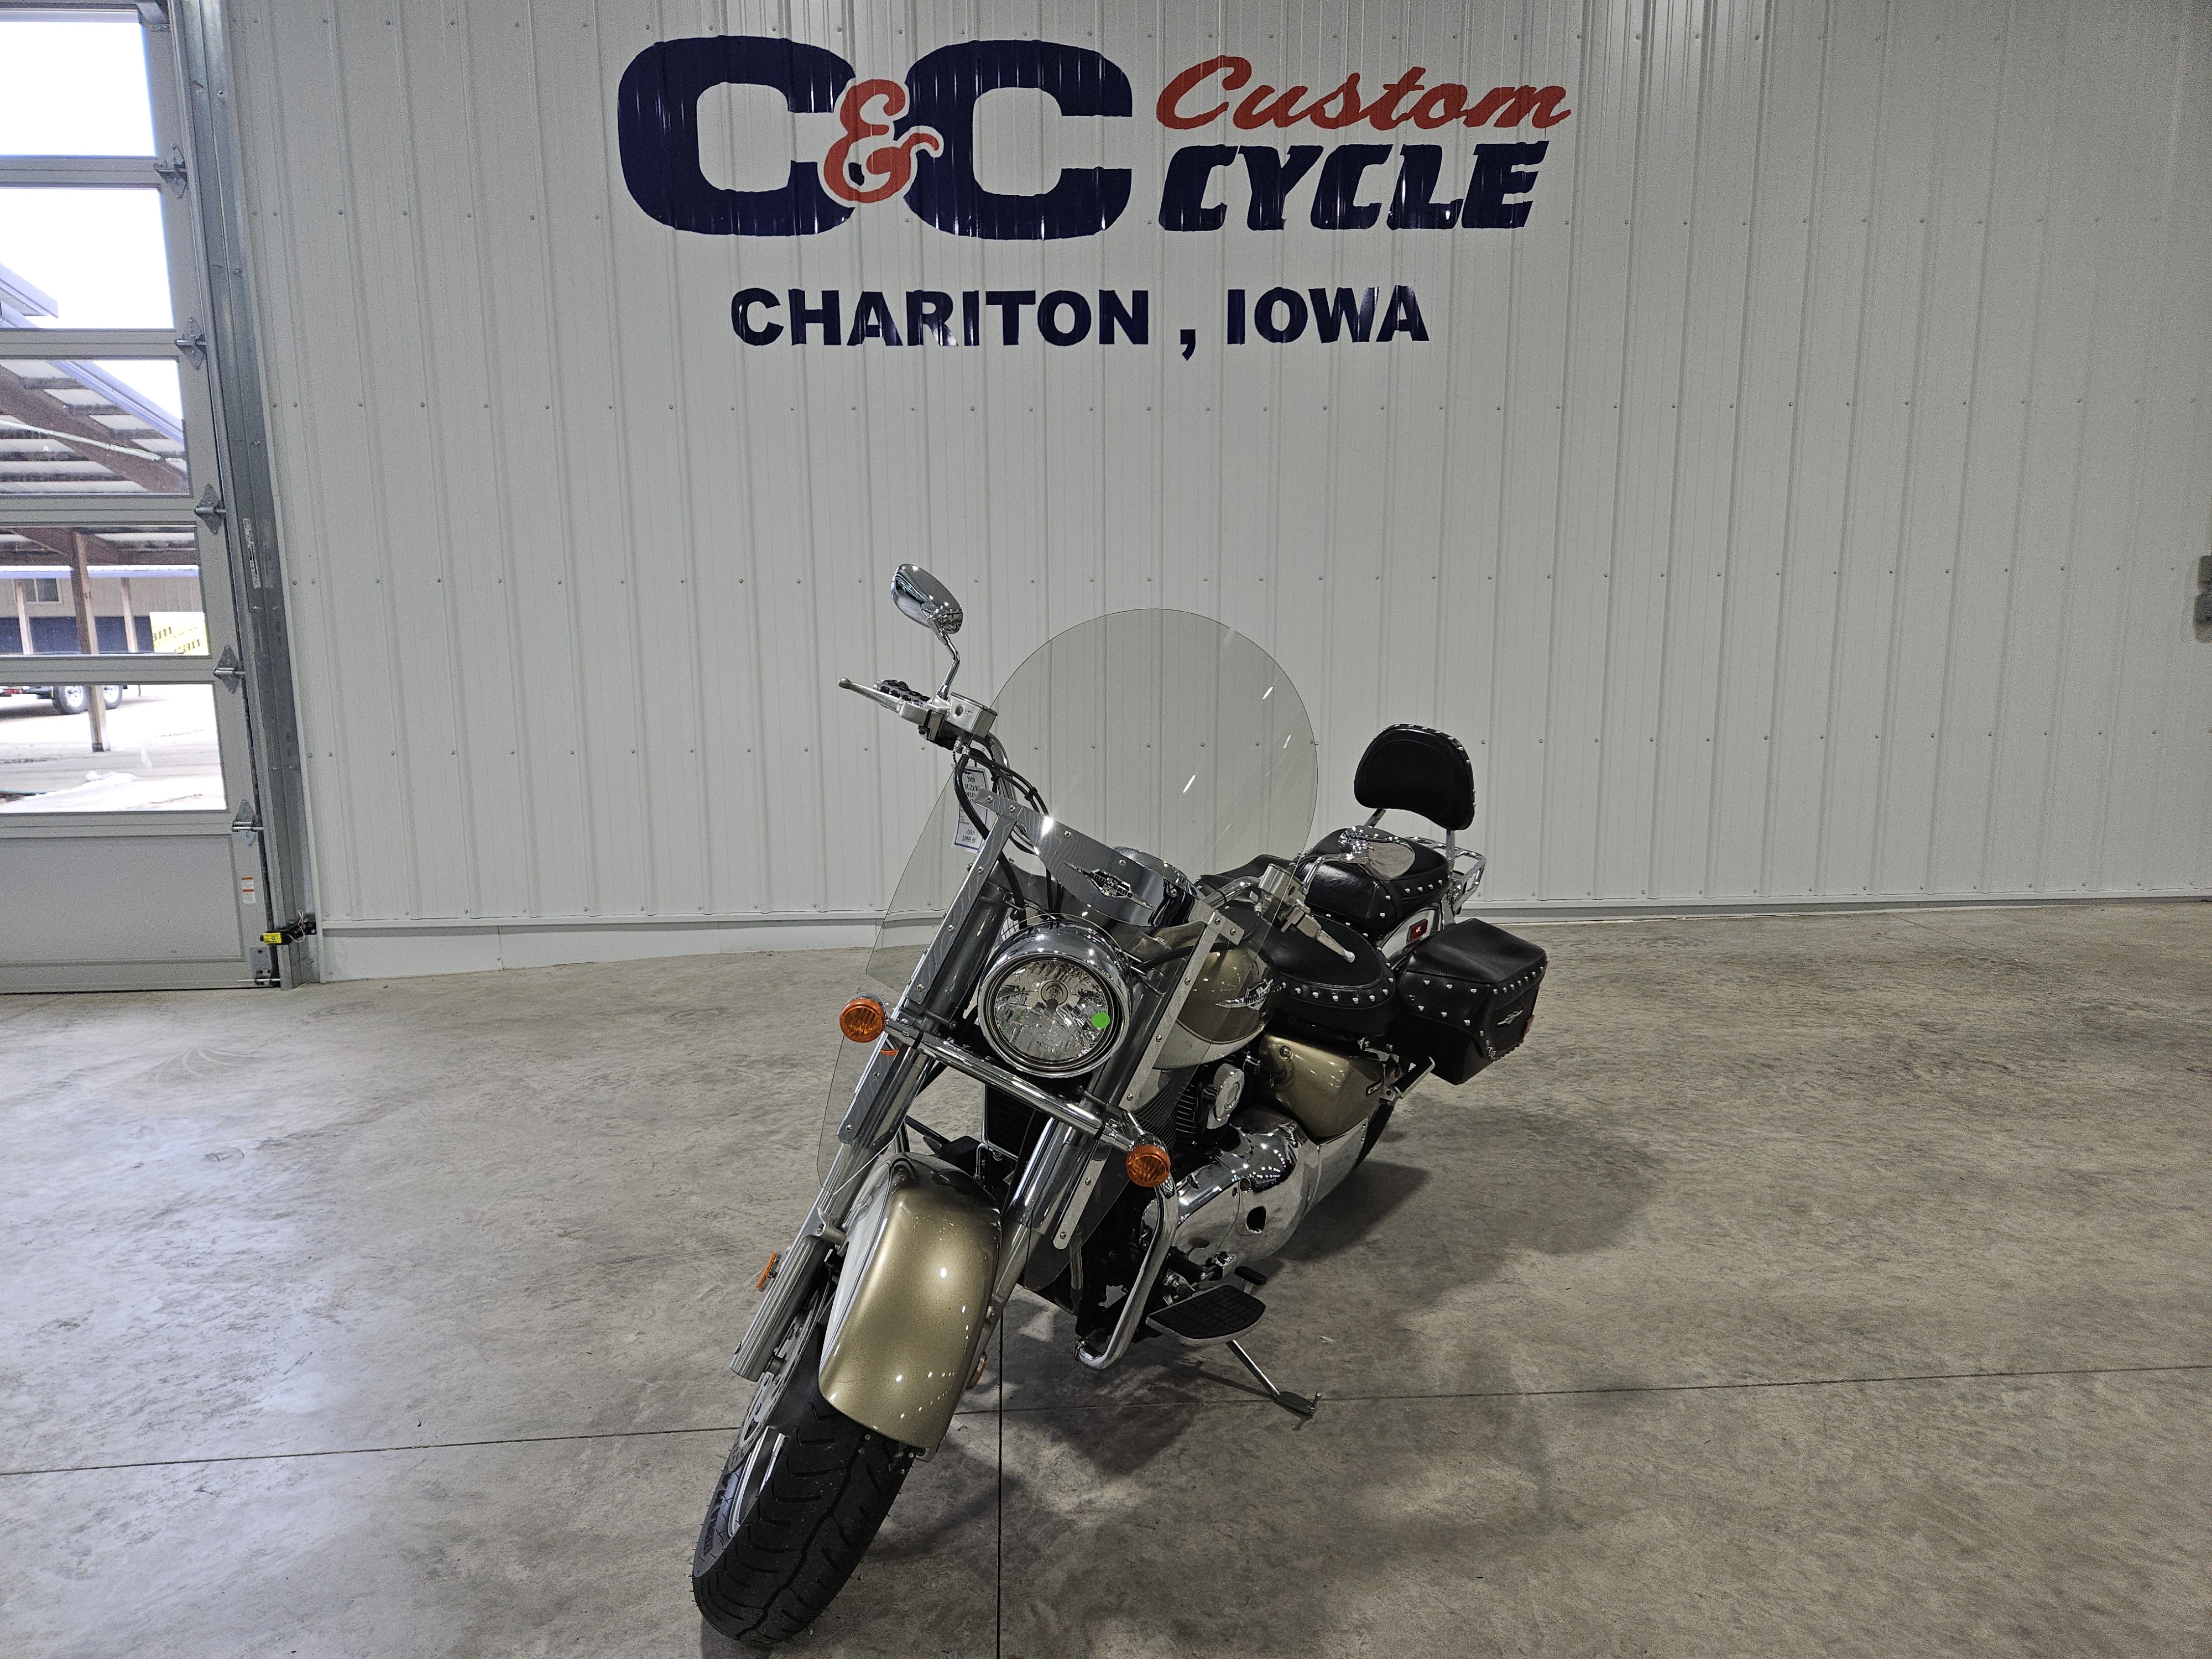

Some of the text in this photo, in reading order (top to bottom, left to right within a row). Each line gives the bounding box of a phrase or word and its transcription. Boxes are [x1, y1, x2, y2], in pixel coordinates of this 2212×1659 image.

[1156, 55, 1572, 131] Custom
[618, 35, 1133, 241] C&C
[1158, 140, 1550, 232] CYCLE
[732, 288, 1149, 347] CHARITON
[1227, 285, 1430, 345] IOWA
